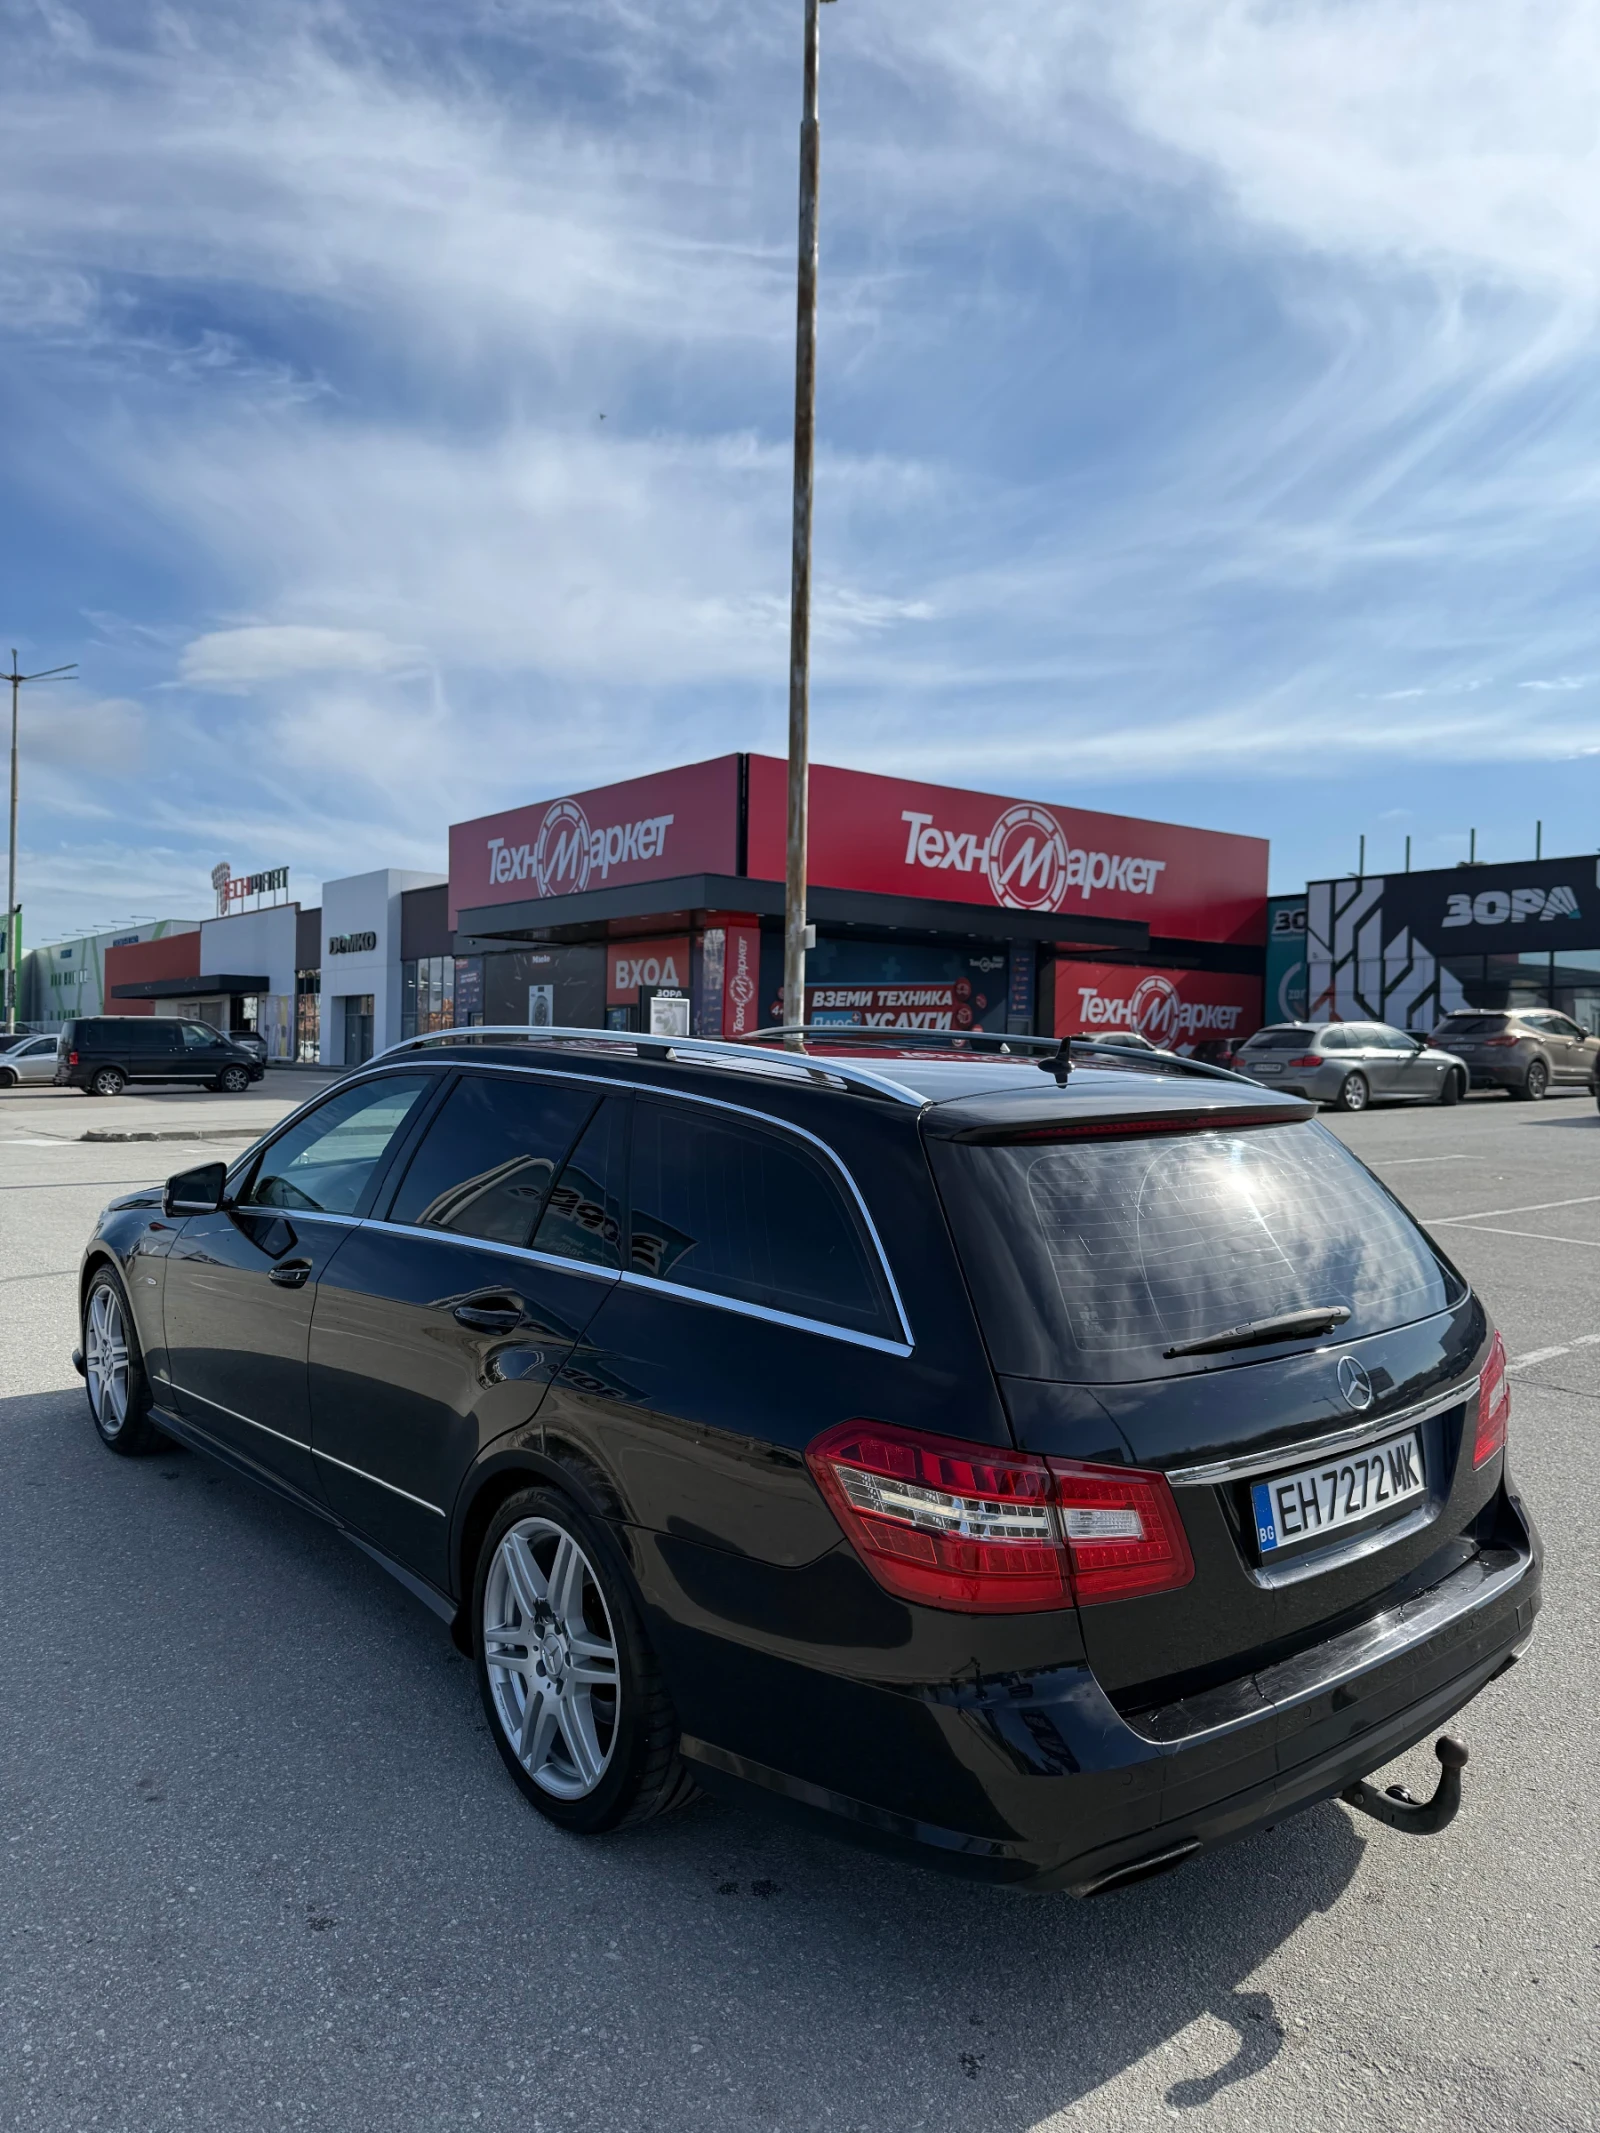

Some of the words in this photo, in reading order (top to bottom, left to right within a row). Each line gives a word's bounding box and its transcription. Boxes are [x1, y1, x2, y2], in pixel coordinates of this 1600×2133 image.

[1441, 886, 1581, 928] ЗОРА
[615, 956, 679, 990] ВХОД
[812, 991, 873, 1008] ВЗЕМИ
[876, 990, 953, 1007] ТЕХНИКА
[1260, 1526, 1275, 1543] BG
